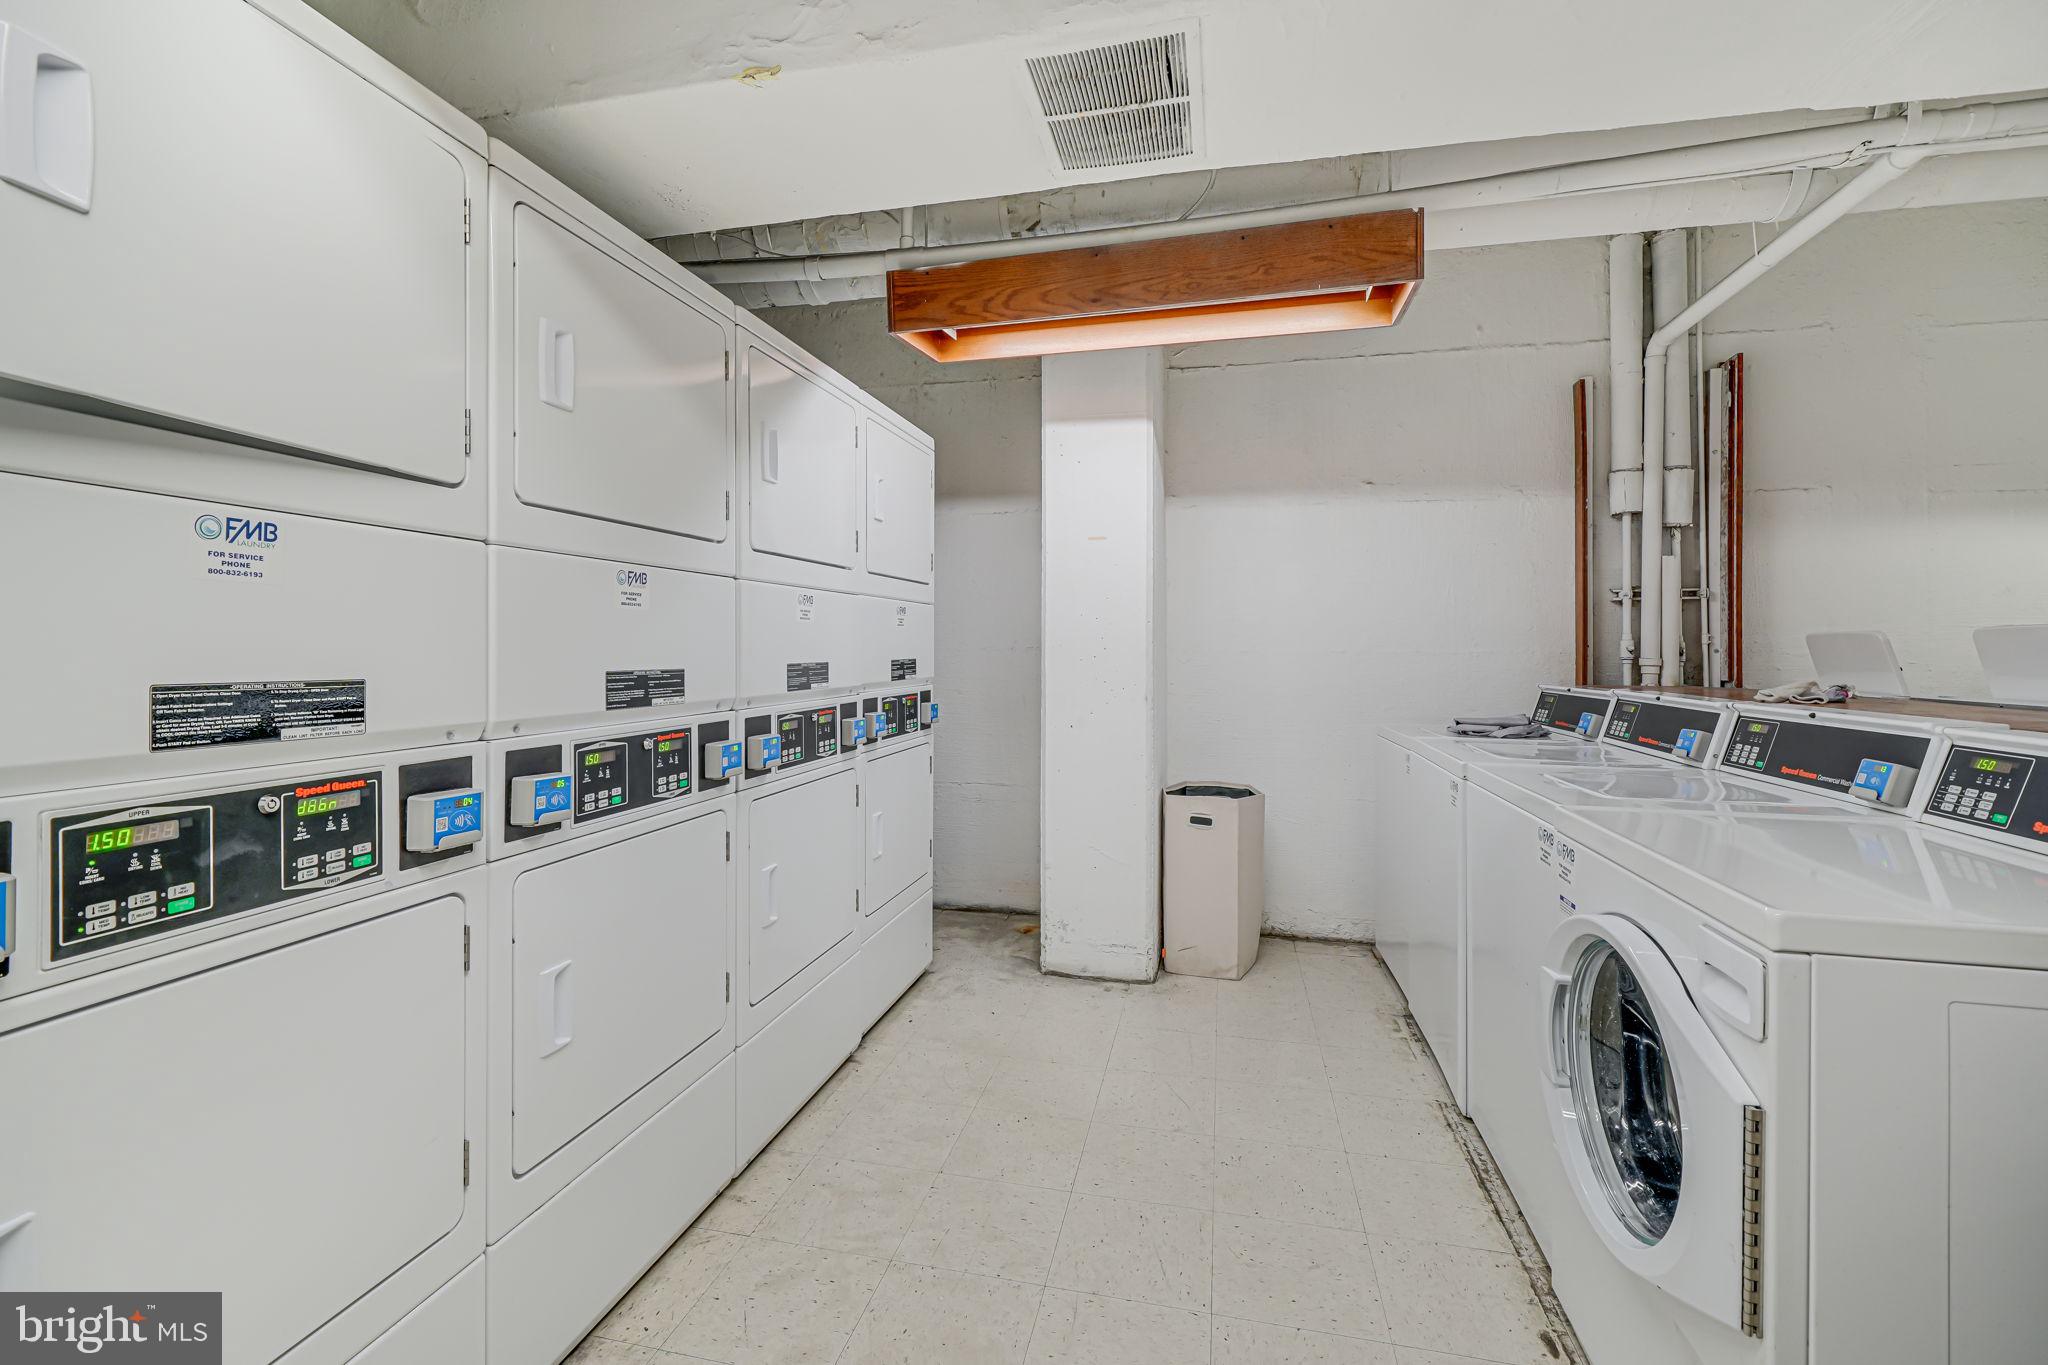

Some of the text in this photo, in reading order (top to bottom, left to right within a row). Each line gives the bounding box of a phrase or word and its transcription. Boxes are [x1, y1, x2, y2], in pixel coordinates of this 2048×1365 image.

[226, 517, 278, 543] FMB
[237, 540, 275, 549] LAUNDRY
[228, 553, 264, 561] SERVICE
[208, 568, 263, 578] 800-832-6193
[628, 571, 647, 587] FMB
[295, 779, 365, 798] Speed Queen
[1563, 844, 1575, 862] FMB
[324, 877, 341, 885] LOWER
